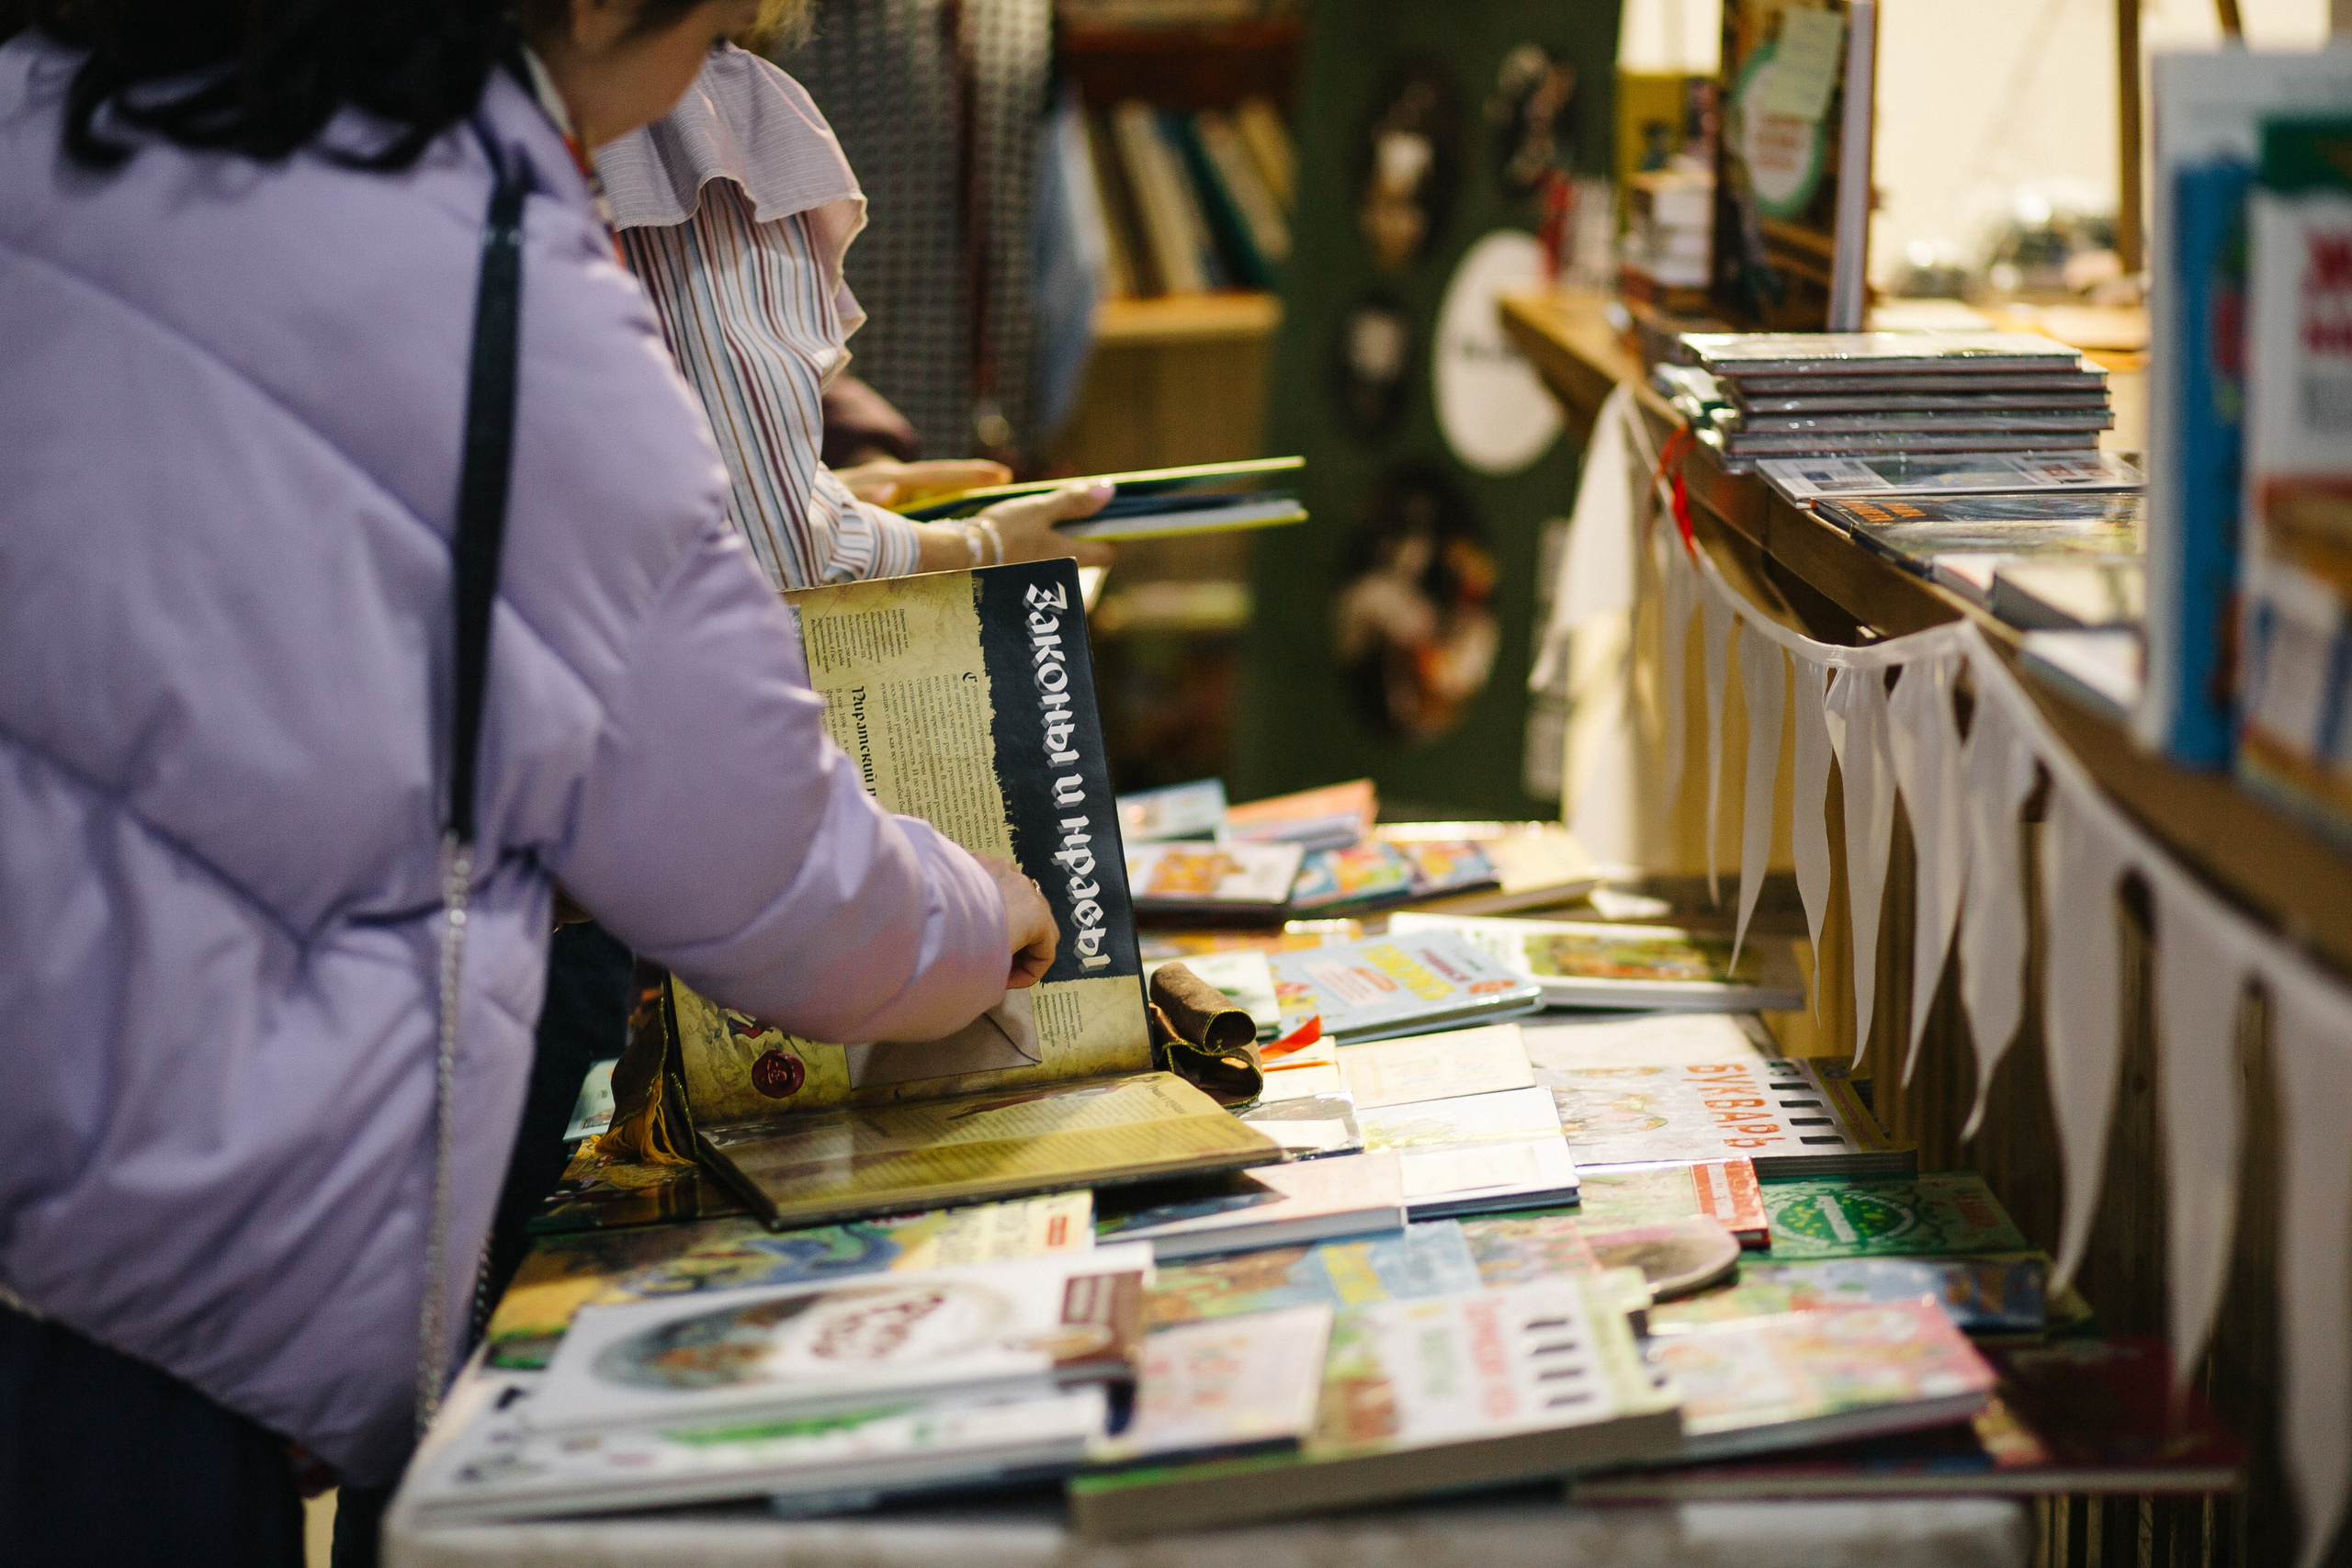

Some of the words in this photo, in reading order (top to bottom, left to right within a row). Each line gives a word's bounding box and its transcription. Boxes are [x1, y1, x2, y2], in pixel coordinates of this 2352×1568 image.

[1025, 581, 1080, 764] Законы
[899, 680, 908, 713] стечения
[943, 674, 953, 708] питались
[839, 712, 847, 728] 1696
[851, 685, 877, 783] Пиратский
[893, 723, 904, 750] разных
[930, 715, 938, 737] время
[947, 709, 958, 745] сухарями
[937, 696, 946, 728] умирали
[942, 741, 950, 756] ран
[946, 766, 959, 813] тропических
[955, 692, 964, 719] пираты
[963, 741, 973, 784] каторжную
[918, 751, 926, 775] морям
[895, 777, 903, 800] якобы
[1055, 773, 1085, 805] и
[985, 836, 993, 848] На
[1054, 815, 1111, 968] нравы
[1681, 1063, 1787, 1148] БУКВАРЬ
